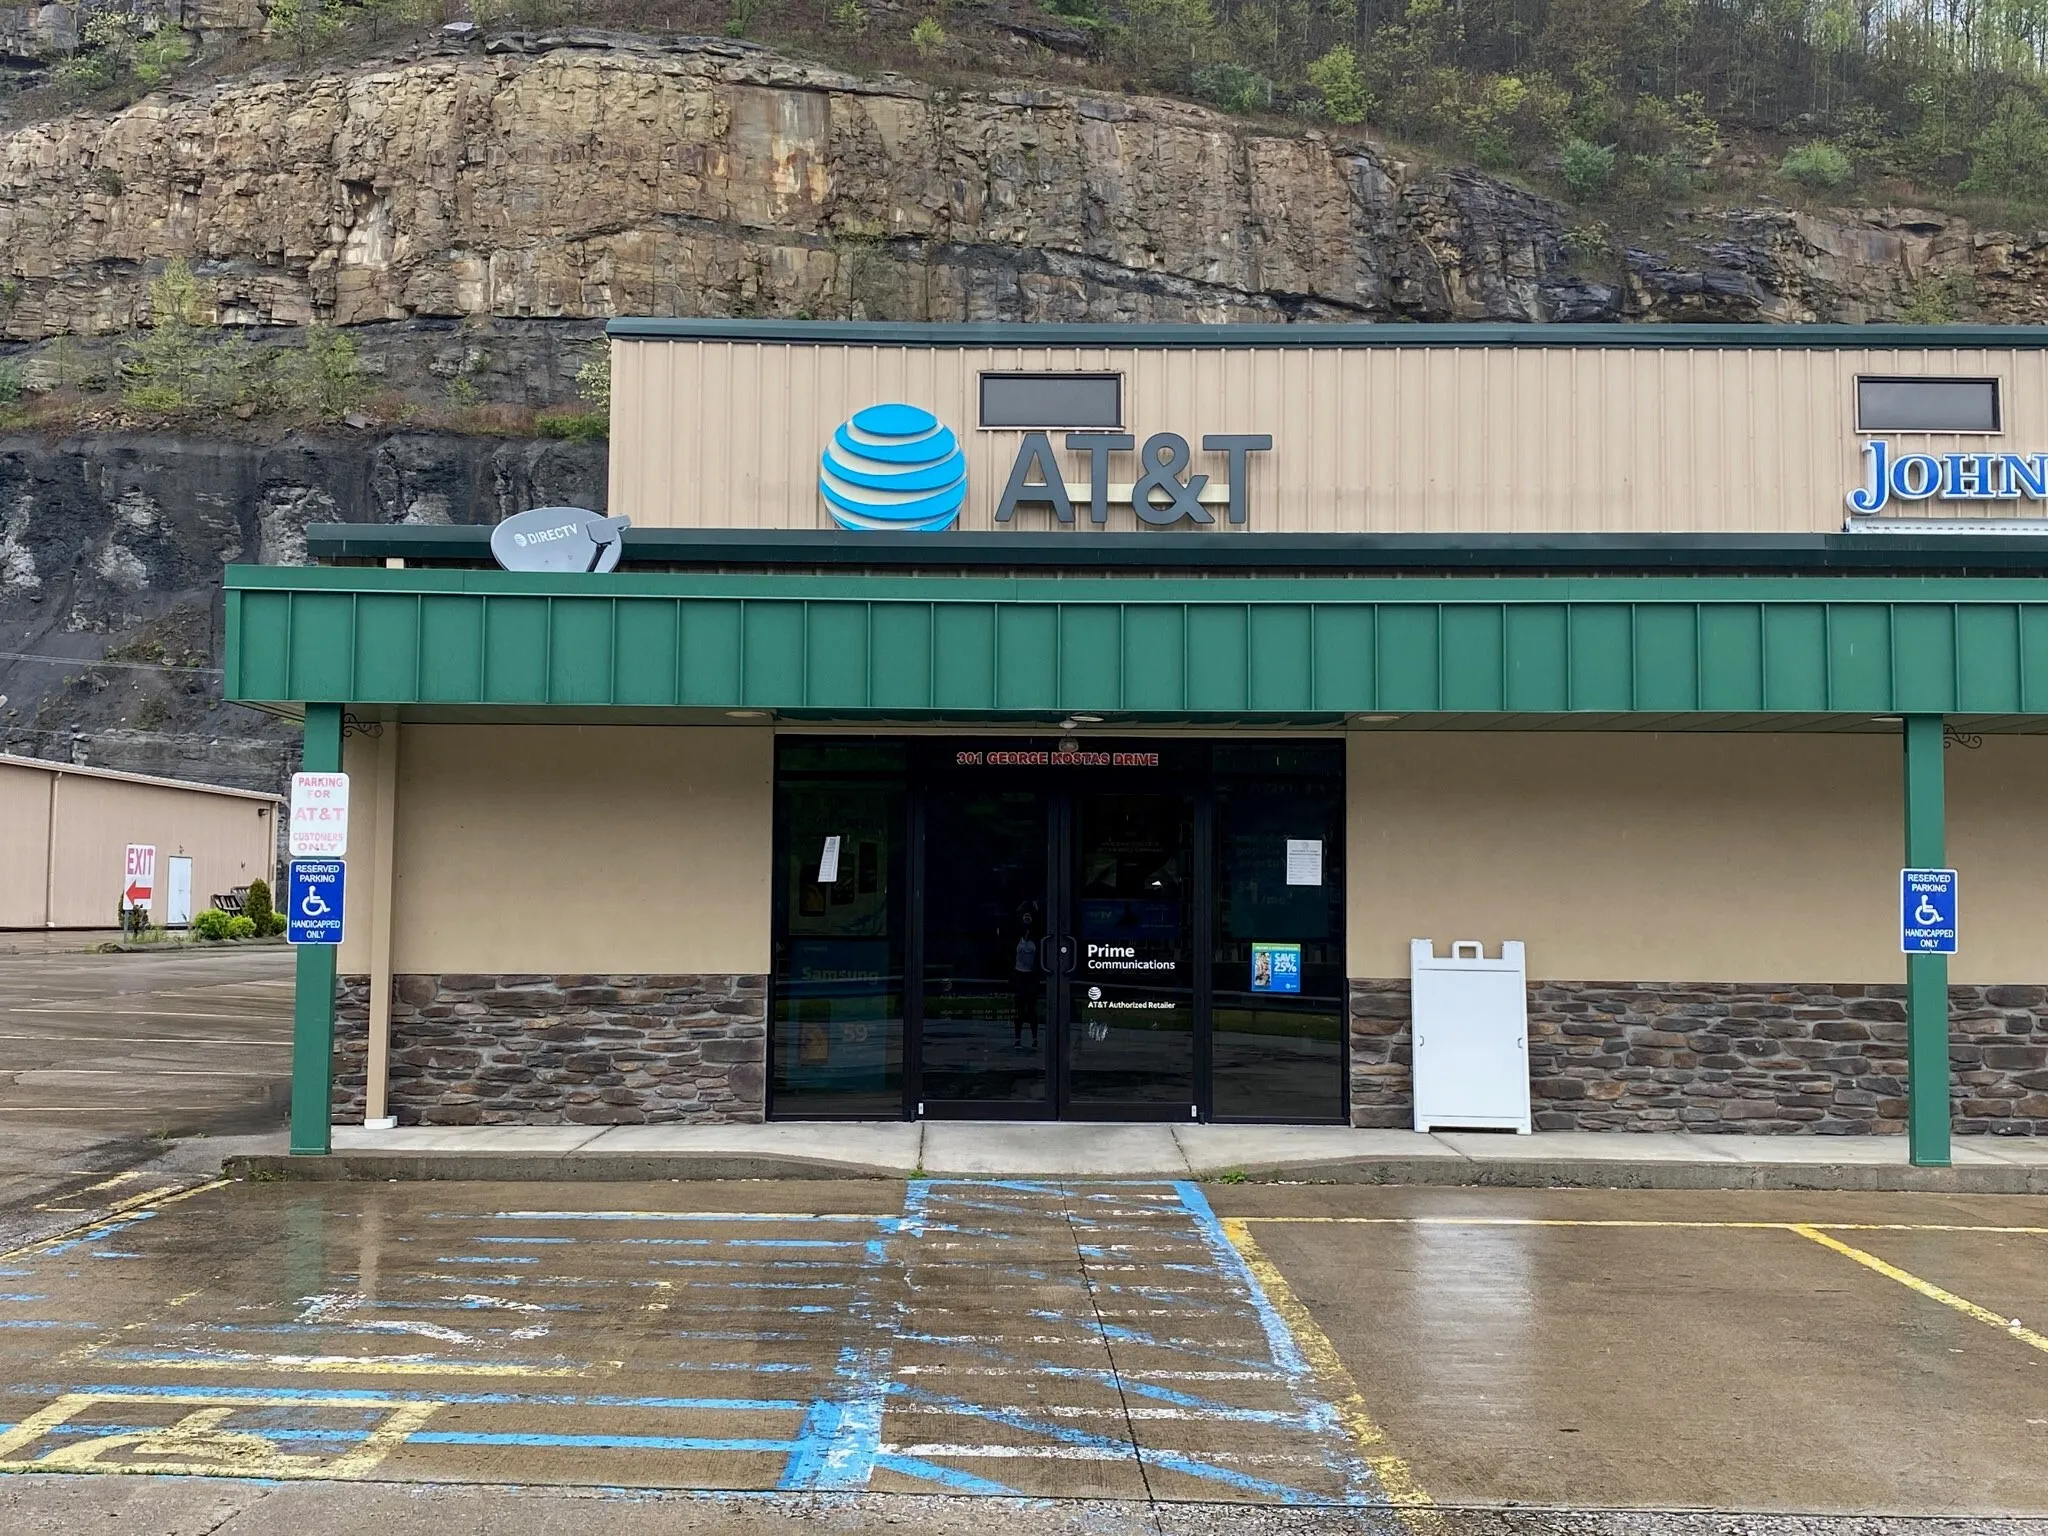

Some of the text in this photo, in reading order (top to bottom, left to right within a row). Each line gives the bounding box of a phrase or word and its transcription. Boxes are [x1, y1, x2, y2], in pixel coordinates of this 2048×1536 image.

[994, 432, 1273, 525] AT&T
[1846, 439, 2048, 516] JOHN
[527, 523, 578, 544] DIRECTV
[956, 751, 1159, 766] 301 GEORGE KOSTAS DRIVE
[299, 777, 343, 787] PARKING
[307, 790, 331, 798] FOR
[294, 807, 345, 821] AT&T
[293, 832, 343, 841] CUSTOMERS
[297, 843, 338, 851] ONLY
[127, 848, 154, 875] EXIT
[295, 864, 340, 873] RESERVED
[299, 874, 336, 883] PARKING
[1907, 874, 1951, 882] RESERVED
[1911, 884, 1947, 892] PARKING
[291, 919, 341, 929] HANDICAPPED
[306, 930, 326, 939] ONLY
[1905, 929, 1954, 938] HANDICAPPED
[1920, 939, 1939, 947] ONLY
[1087, 943, 1135, 958] Prime
[1274, 953, 1297, 962] SAVE
[1087, 959, 1176, 970] Communications
[1274, 962, 1297, 972] 25%
[802, 967, 880, 985] Samsung
[1087, 1001, 1176, 1009] AT&T Authorized Retailer
